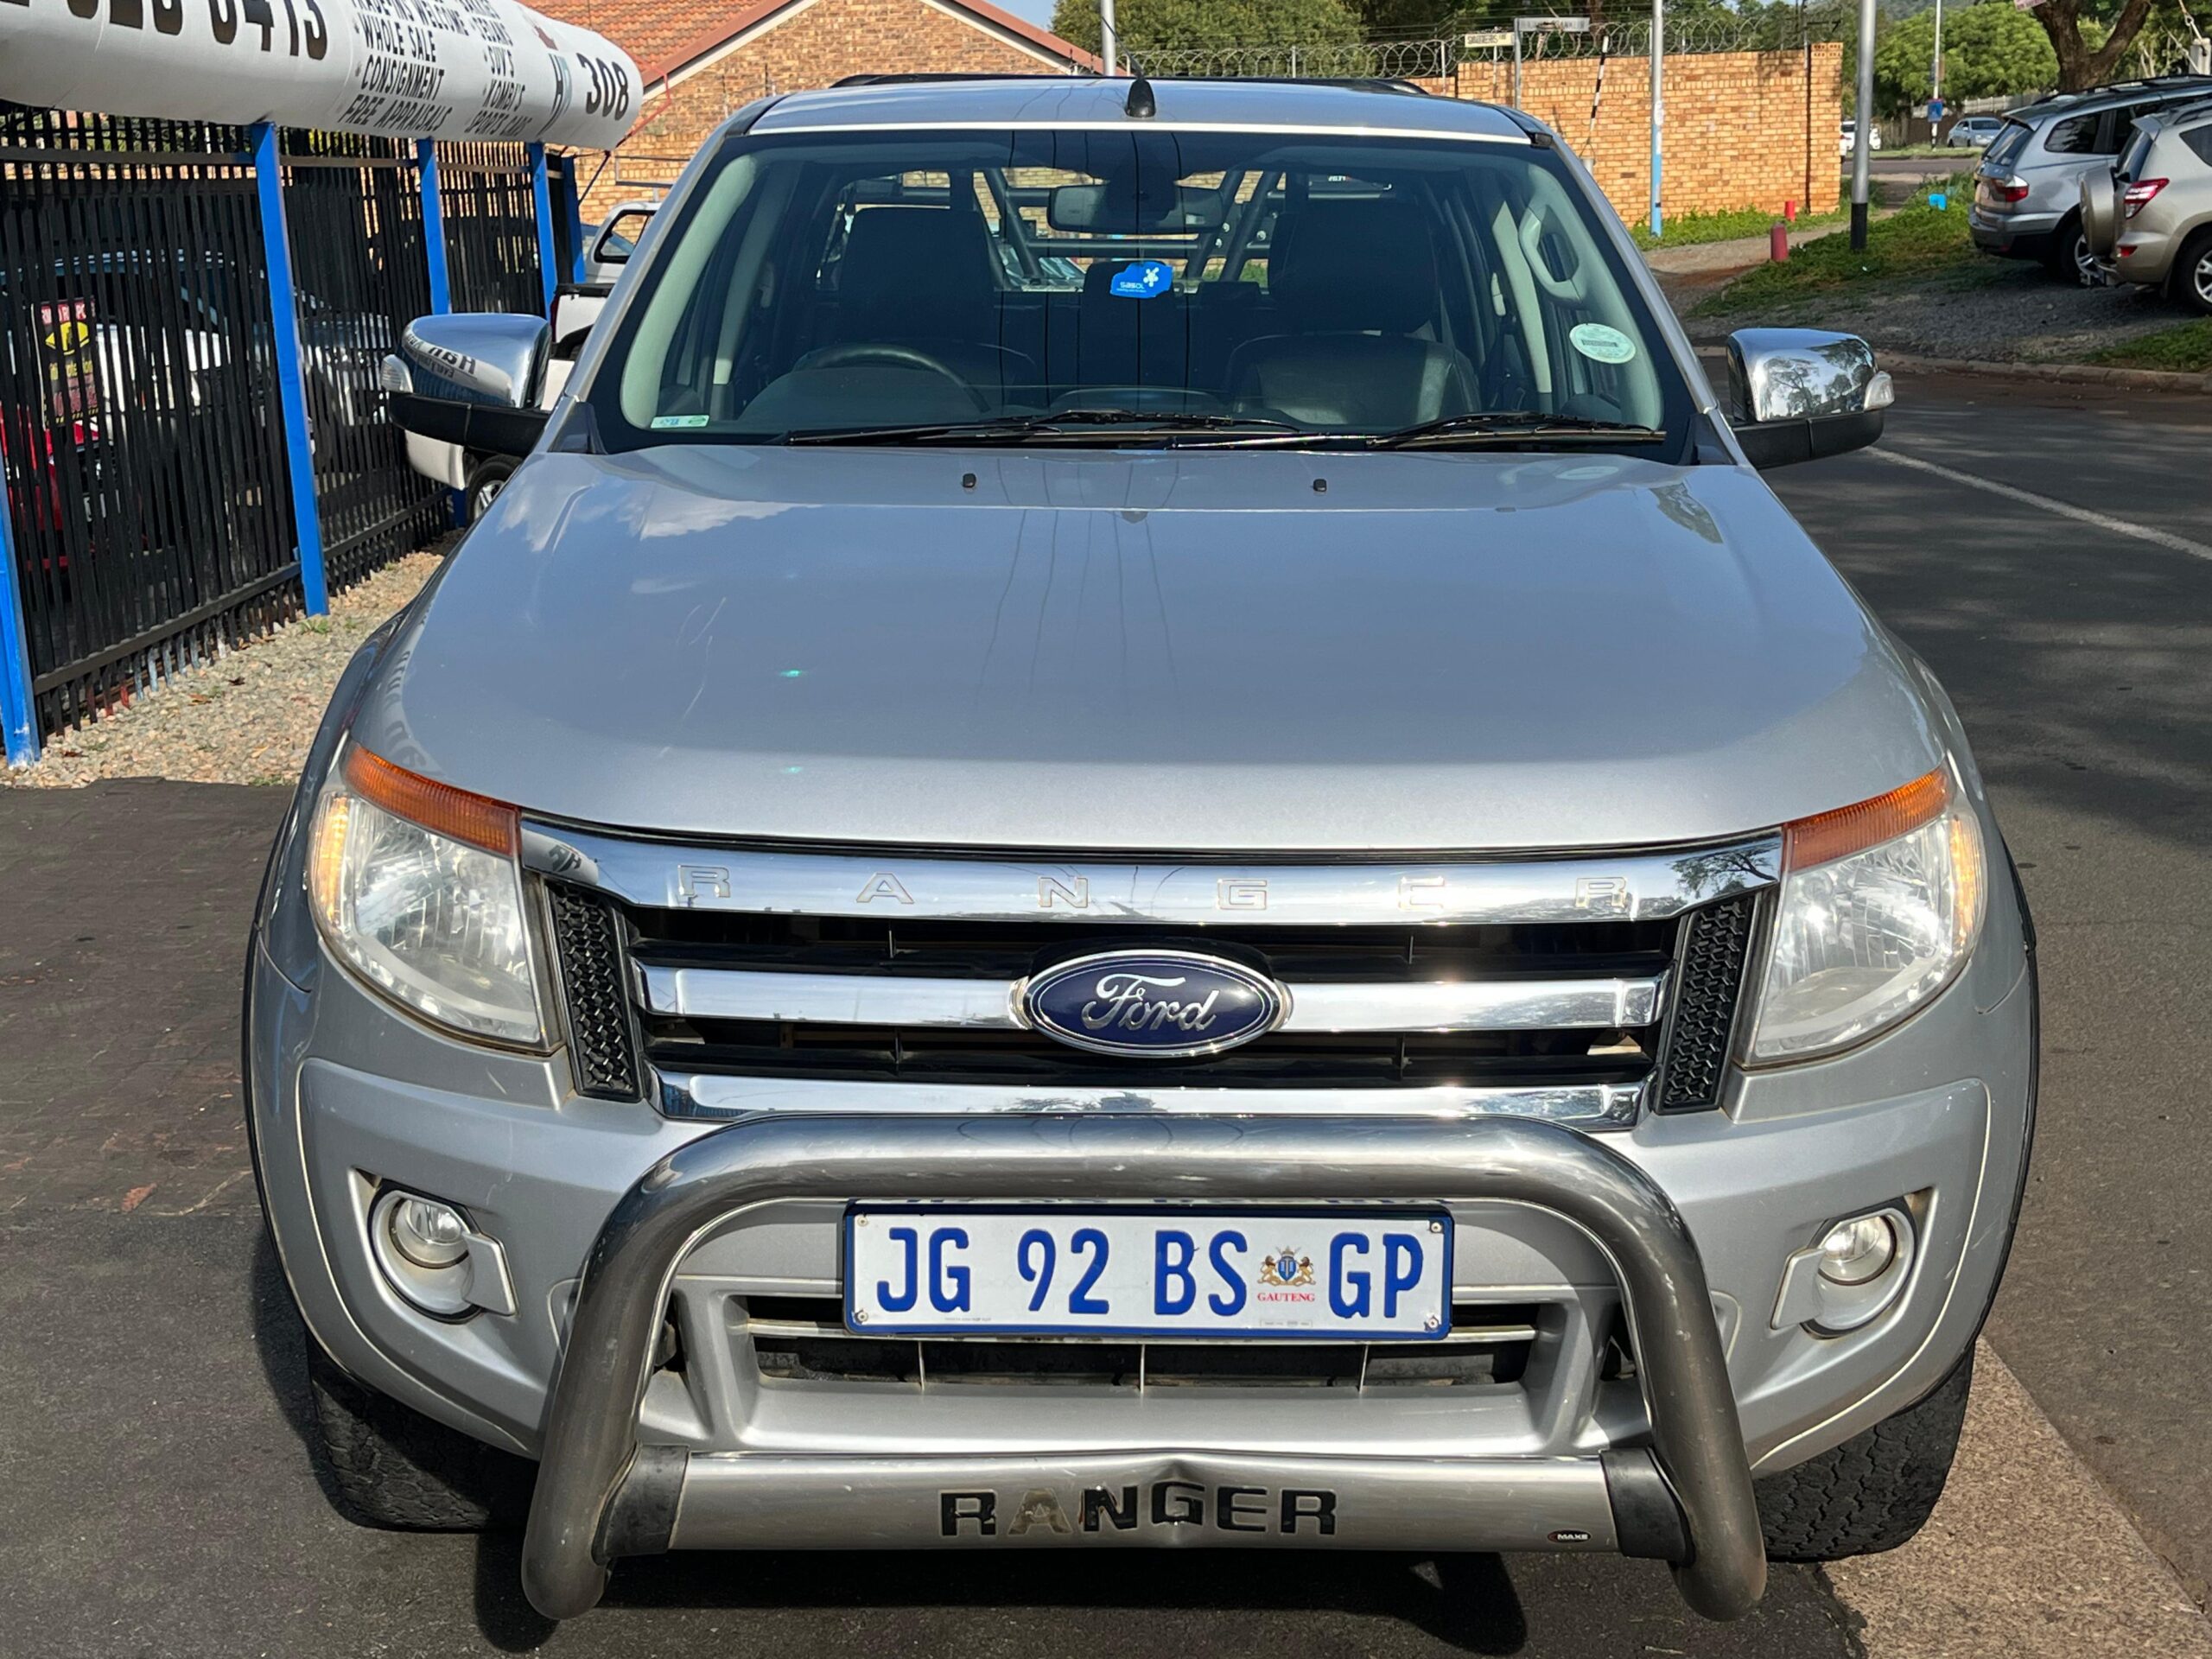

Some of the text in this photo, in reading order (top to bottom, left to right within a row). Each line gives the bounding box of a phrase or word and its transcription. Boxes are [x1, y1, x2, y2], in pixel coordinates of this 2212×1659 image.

[358, 12, 436, 62] WHOLE SALE
[361, 54, 445, 101] CONSIGNMENT
[576, 53, 629, 121] 308
[338, 93, 453, 131] FREE APPRAISALS
[678, 864, 1626, 910] RANGER
[1082, 973, 1220, 1031] Ford
[877, 1227, 1424, 1319] JG 92 BS GP
[1257, 1293, 1315, 1301] GAUTENG
[939, 1480, 1337, 1535] RANGER
